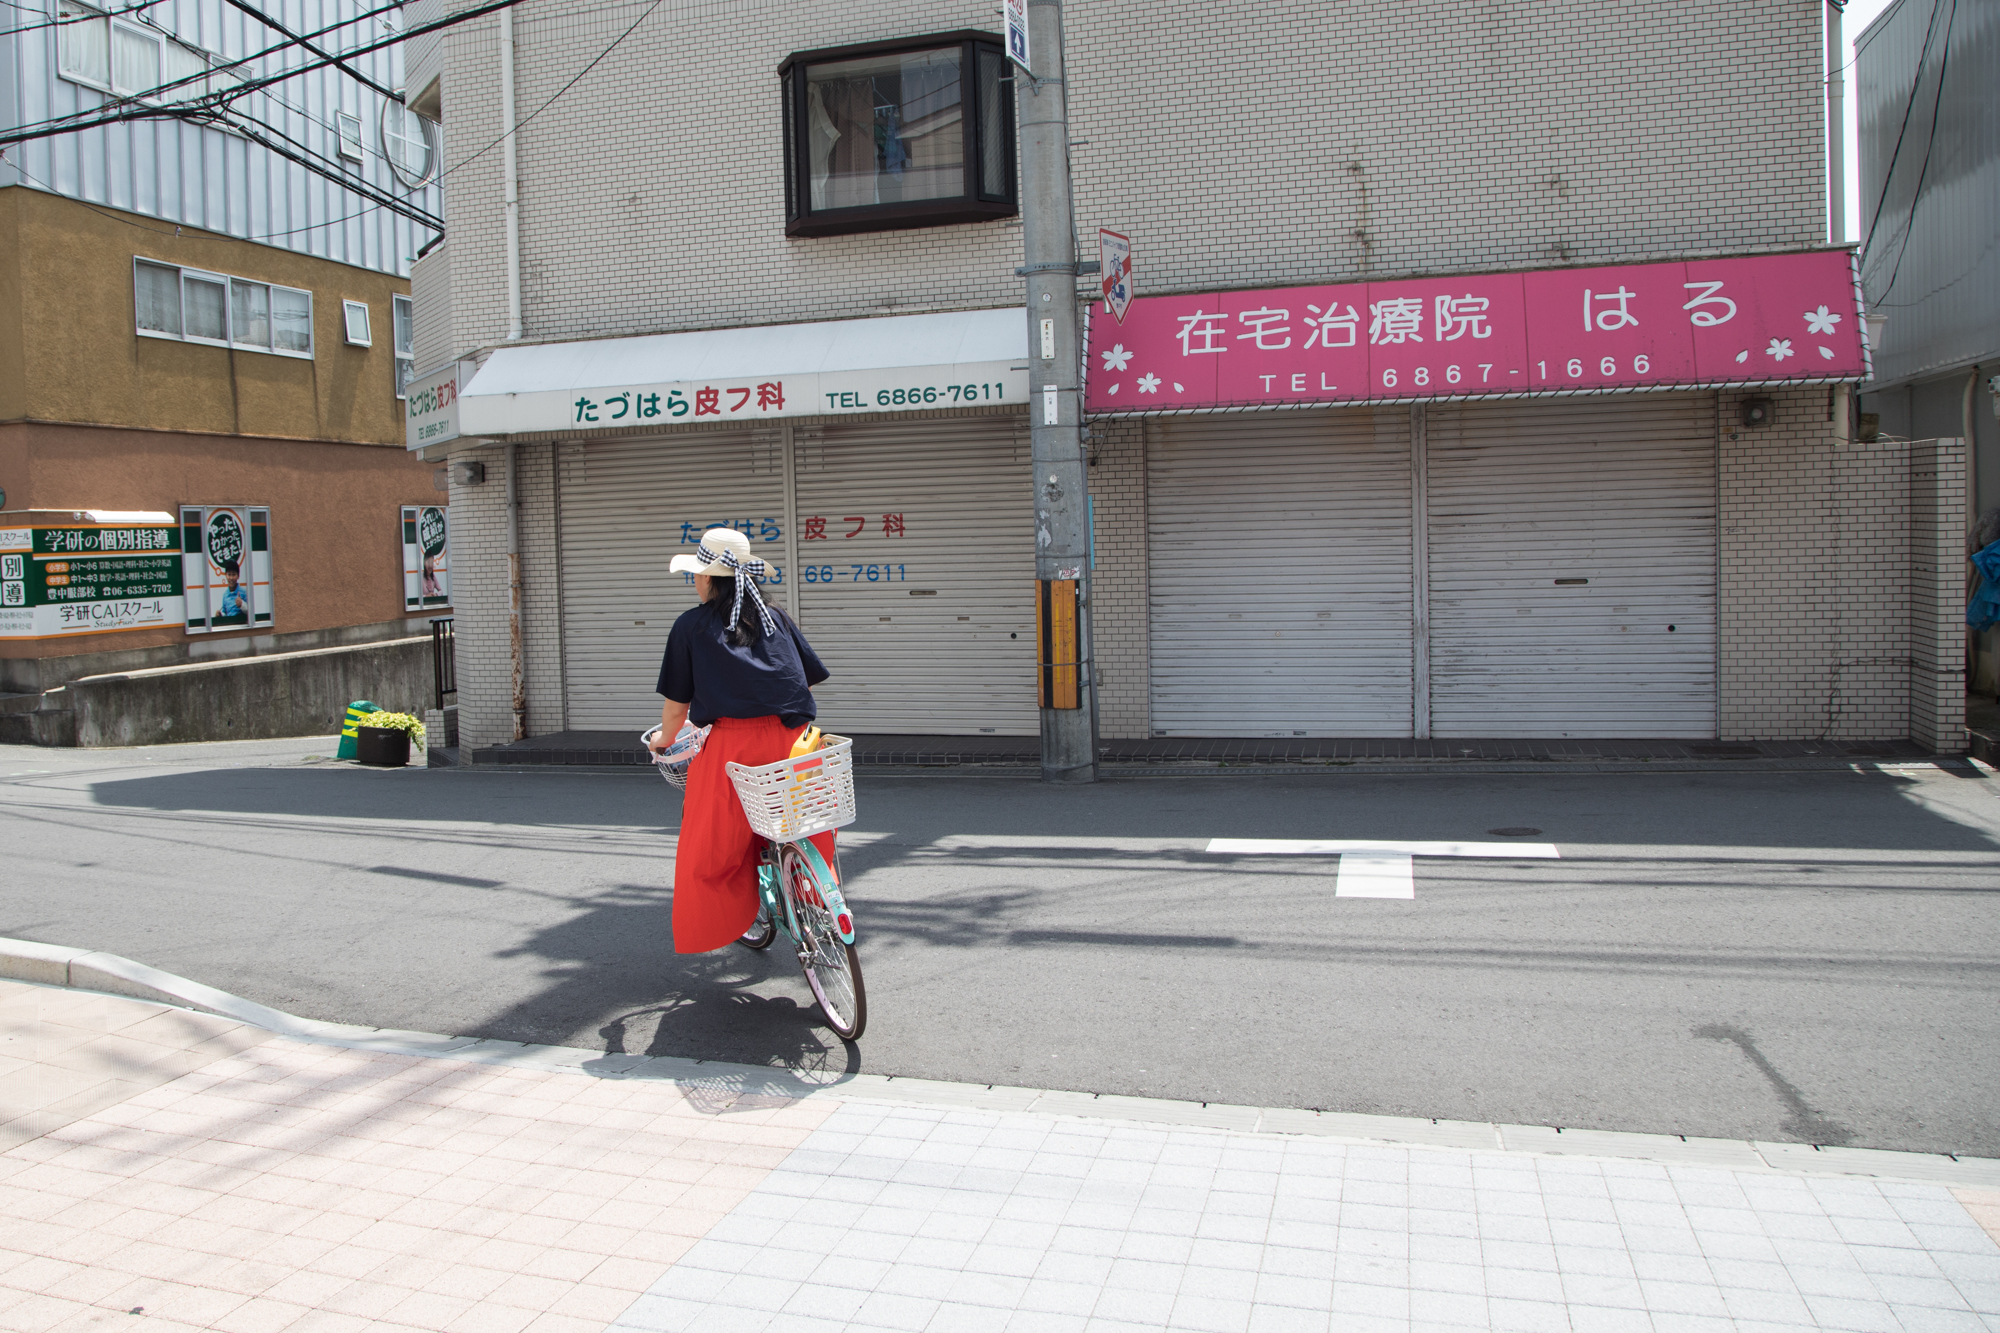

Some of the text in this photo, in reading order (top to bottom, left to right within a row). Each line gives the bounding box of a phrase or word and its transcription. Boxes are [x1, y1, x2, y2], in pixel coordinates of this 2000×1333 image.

[1176, 281, 1737, 356] 在宅治療院 はる
[1259, 354, 1650, 393] TEL 6867-1666
[409, 378, 457, 418] たづはら皮フ科
[575, 381, 785, 422] たづはら皮フ科
[826, 382, 1003, 409] TEL 6866-7611
[45, 529, 170, 552] 学研の個別指導
[210, 530, 240, 551] わかった
[804, 514, 905, 541] 皮フ科
[47, 584, 172, 600] 豊中服部校 06-6335-7702
[60, 600, 164, 622] 学研CAIスクール
